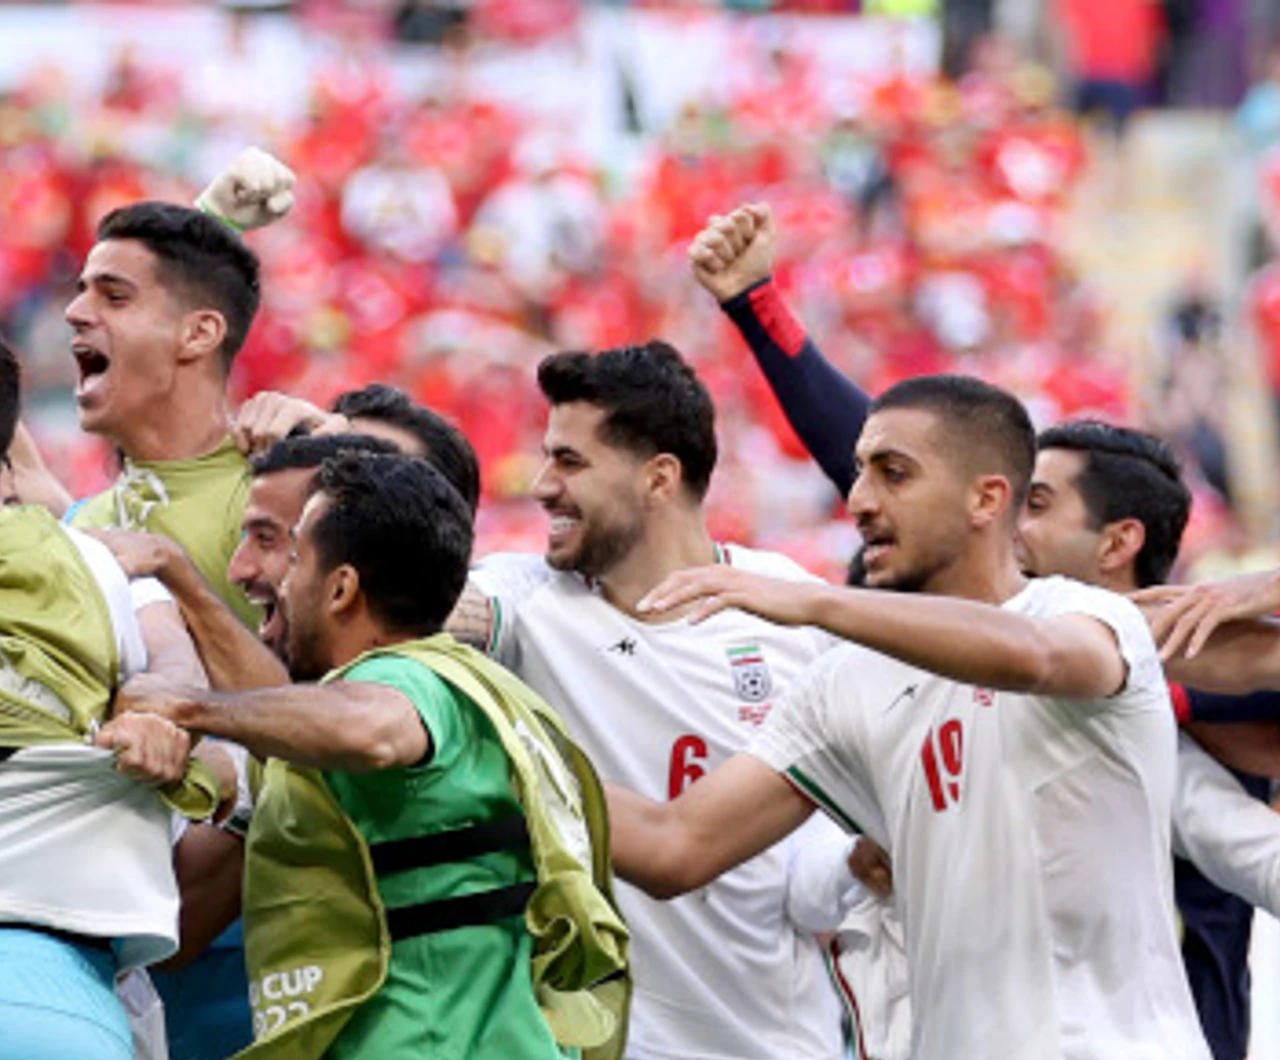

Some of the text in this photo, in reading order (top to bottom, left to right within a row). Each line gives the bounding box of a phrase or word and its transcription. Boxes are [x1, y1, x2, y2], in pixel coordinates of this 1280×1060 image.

[667, 733, 707, 802] 6
[920, 718, 963, 812] 19
[262, 965, 323, 1000] CUP
